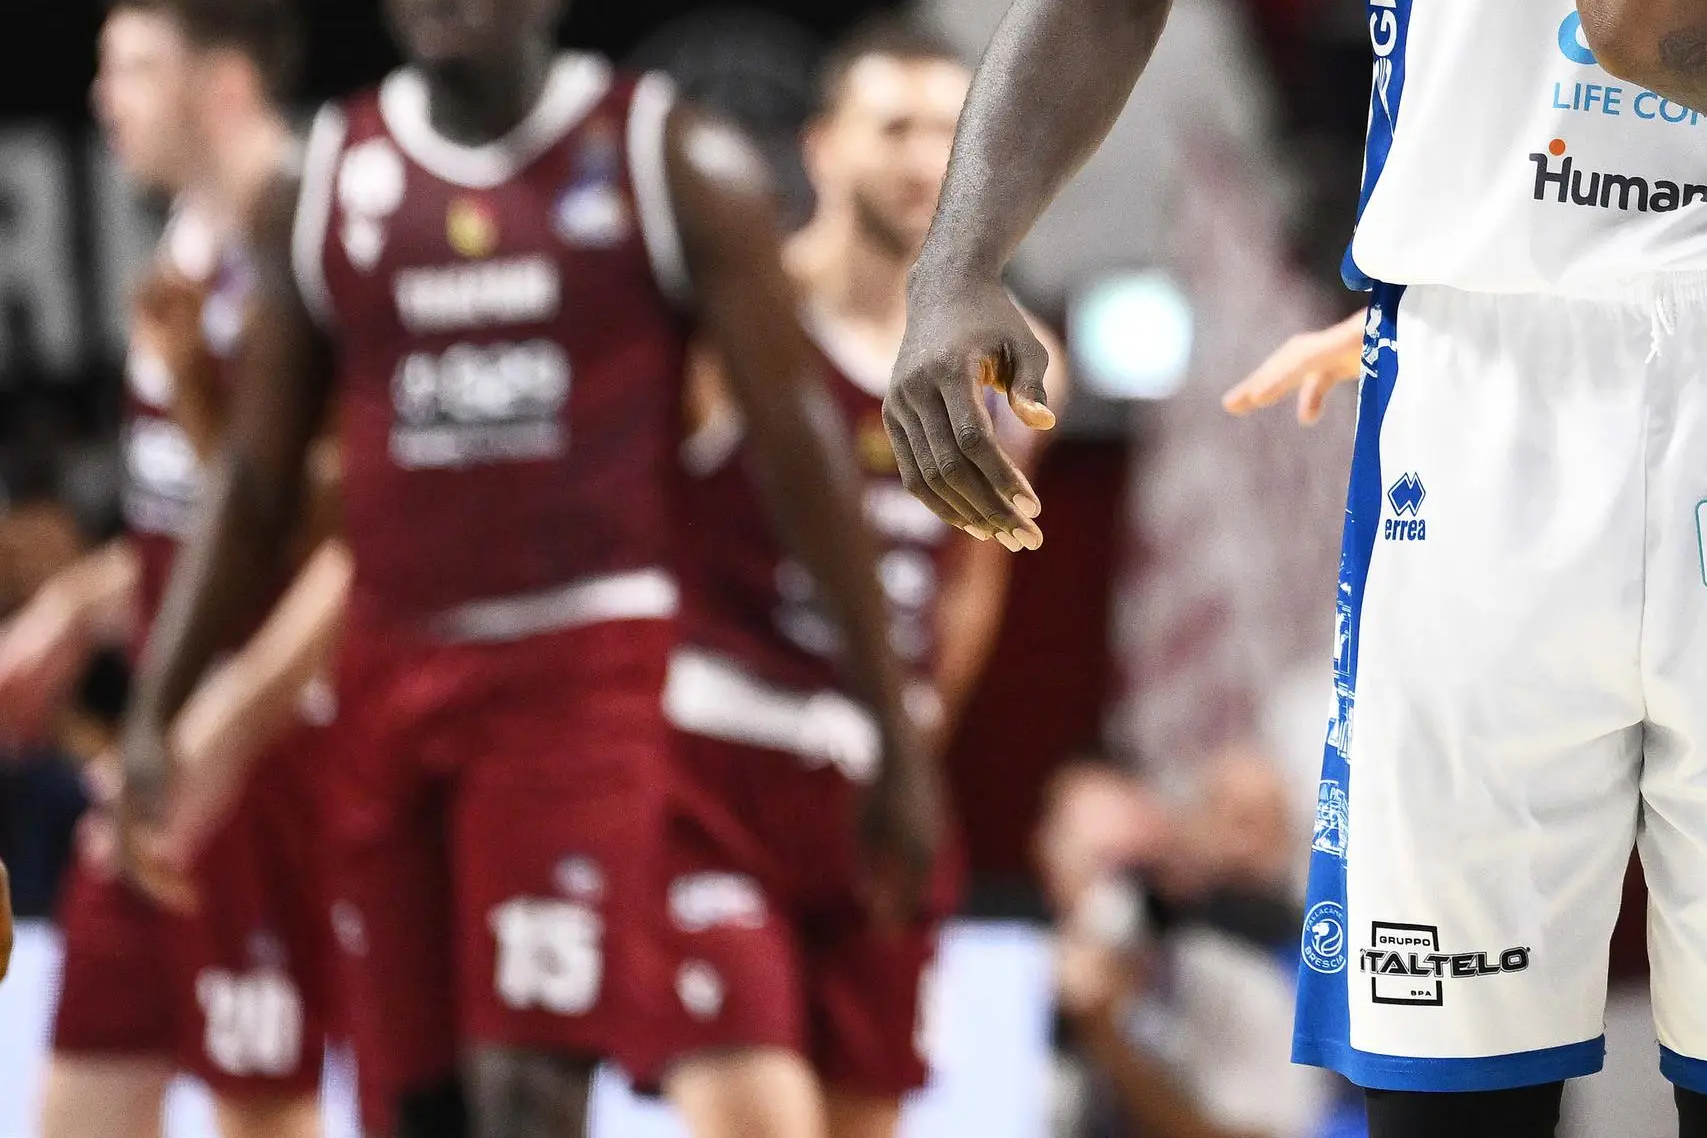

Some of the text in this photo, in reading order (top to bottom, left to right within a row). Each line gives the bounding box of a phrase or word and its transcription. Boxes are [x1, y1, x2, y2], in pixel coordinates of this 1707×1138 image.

[1551, 81, 1624, 116] LIFE
[1384, 517, 1427, 542] errea
[1379, 935, 1432, 947] GRUPPO
